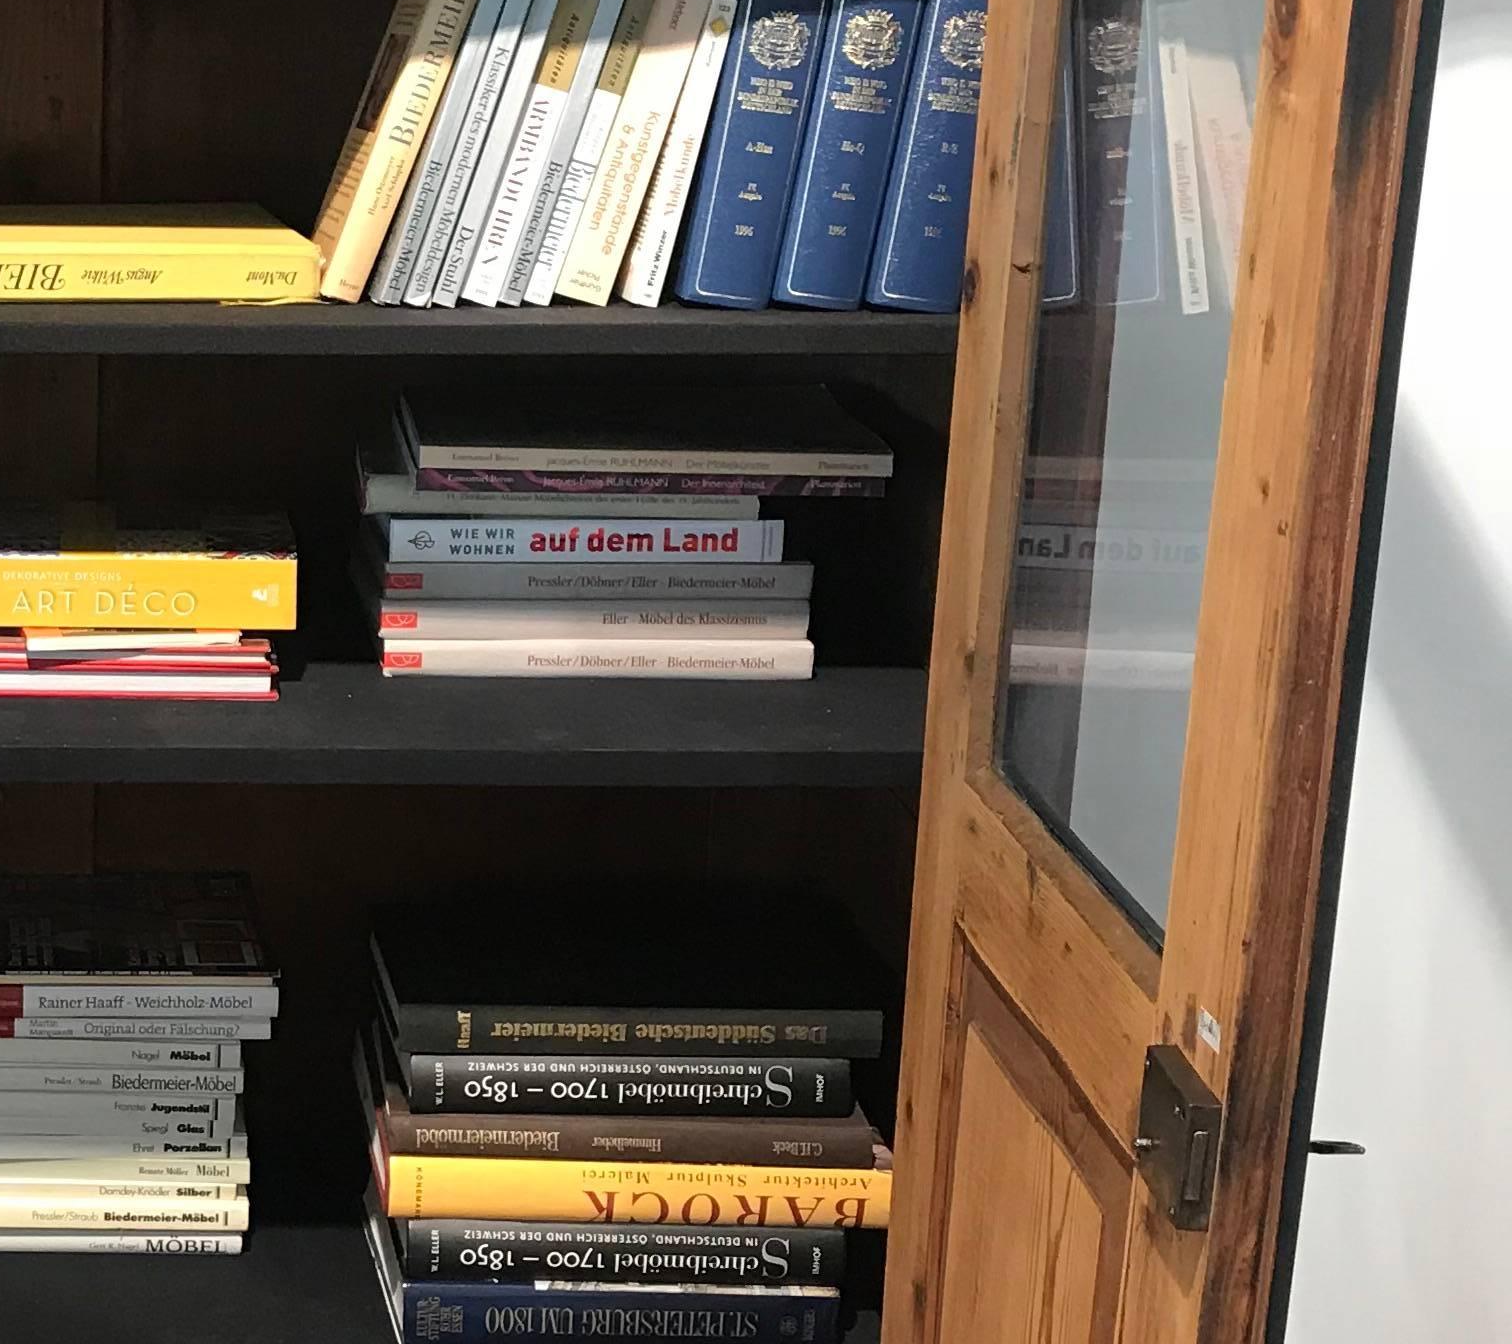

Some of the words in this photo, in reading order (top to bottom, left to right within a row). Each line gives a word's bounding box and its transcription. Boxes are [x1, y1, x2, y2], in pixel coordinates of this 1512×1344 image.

[550, 13, 580, 84] Antiquitäten
[479, 46, 510, 111] Klassiker
[469, 107, 488, 135] des
[445, 135, 477, 207] modernen
[388, 159, 443, 292] Biedermeier-Möbel
[507, 159, 564, 293] Biedermeier-Möbel
[454, 225, 475, 254] Der
[652, 229, 668, 263] Winzer
[415, 209, 457, 294] Möbeldesign
[80, 269, 123, 285] Wilkie
[121, 269, 164, 285] Angus
[246, 270, 298, 286] DuMont
[439, 253, 465, 294] Stuhl
[647, 261, 658, 287] Fritz
[450, 527, 479, 540] WIE
[485, 527, 515, 539] WIR
[529, 526, 580, 552] auf
[587, 527, 654, 552] dem
[663, 527, 739, 552] Land
[449, 544, 515, 556] WOHNEN
[2, 570, 70, 582] DEKORATIVE
[74, 571, 123, 582] DESIGNS
[527, 574, 658, 590] Pressler/Döbner/Eller
[667, 575, 776, 590] Biedermeier-Möbel
[10, 589, 76, 616] ART
[93, 583, 199, 617] DÉCO
[602, 613, 629, 625] Eller
[637, 612, 674, 625] Möbel
[676, 613, 695, 625] des
[697, 613, 768, 625] Klassizismus
[526, 654, 658, 670] Pressler/Döbner/Eller
[667, 655, 776, 671] Biedermeier-Möbel
[37, 995, 84, 1009] Rainer
[85, 995, 125, 1009] Haaff
[134, 995, 253, 1009] Weichholz-Möbel
[83, 1022, 136, 1038] Original
[138, 1022, 168, 1035] oder
[170, 1023, 241, 1039] Fälschung?
[489, 1021, 628, 1043] Biedermeier
[635, 1023, 777, 1045] Süddeutsche
[784, 1024, 828, 1045] Das
[130, 1048, 161, 1063] Nagel
[168, 1049, 212, 1062] Möbel
[467, 1061, 519, 1072] SCHWEIZ
[523, 1062, 546, 1072] DER
[550, 1062, 576, 1072] UND
[655, 1064, 745, 1075] DEUTSCHLAND,
[748, 1065, 762, 1075] IN
[111, 1072, 237, 1091] Biedermeier-Möbel
[463, 1075, 519, 1103] 1850
[550, 1077, 609, 1100] 1700
[616, 1064, 794, 1109] Schreibmöbel
[814, 1072, 825, 1103] IMHOF
[150, 1101, 211, 1115] Jugendstil
[176, 1122, 206, 1134] Glas
[163, 1143, 223, 1153] Porzellan
[415, 1128, 561, 1152] Biedermeiermöbel
[591, 1135, 663, 1154] Himmelheber
[195, 1163, 230, 1177] Möbel
[581, 1169, 651, 1186] Malerei
[665, 1170, 748, 1188] Skulptur
[762, 1174, 873, 1190] Architektur
[175, 1187, 212, 1197] Silber
[31, 1211, 99, 1223] Pressler/Straub
[103, 1211, 219, 1223] Biedermeier-Möbel
[581, 1189, 871, 1229] BAROCK
[144, 1235, 225, 1254] MÖBEL
[463, 1229, 515, 1241] SCHWEIZ
[519, 1231, 542, 1241] DER
[547, 1232, 573, 1242] UND
[651, 1234, 741, 1247] DEUTSCHLAND,
[745, 1236, 759, 1247] IN
[459, 1243, 515, 1271] 1850
[546, 1247, 606, 1269] 1700
[613, 1236, 791, 1280] Schreibmöbel
[810, 1245, 822, 1275] IMHOF
[484, 1305, 535, 1335] 1800
[540, 1307, 574, 1336] UM
[582, 1307, 726, 1338] PETERSBURG
[729, 1309, 759, 1338] ST.
